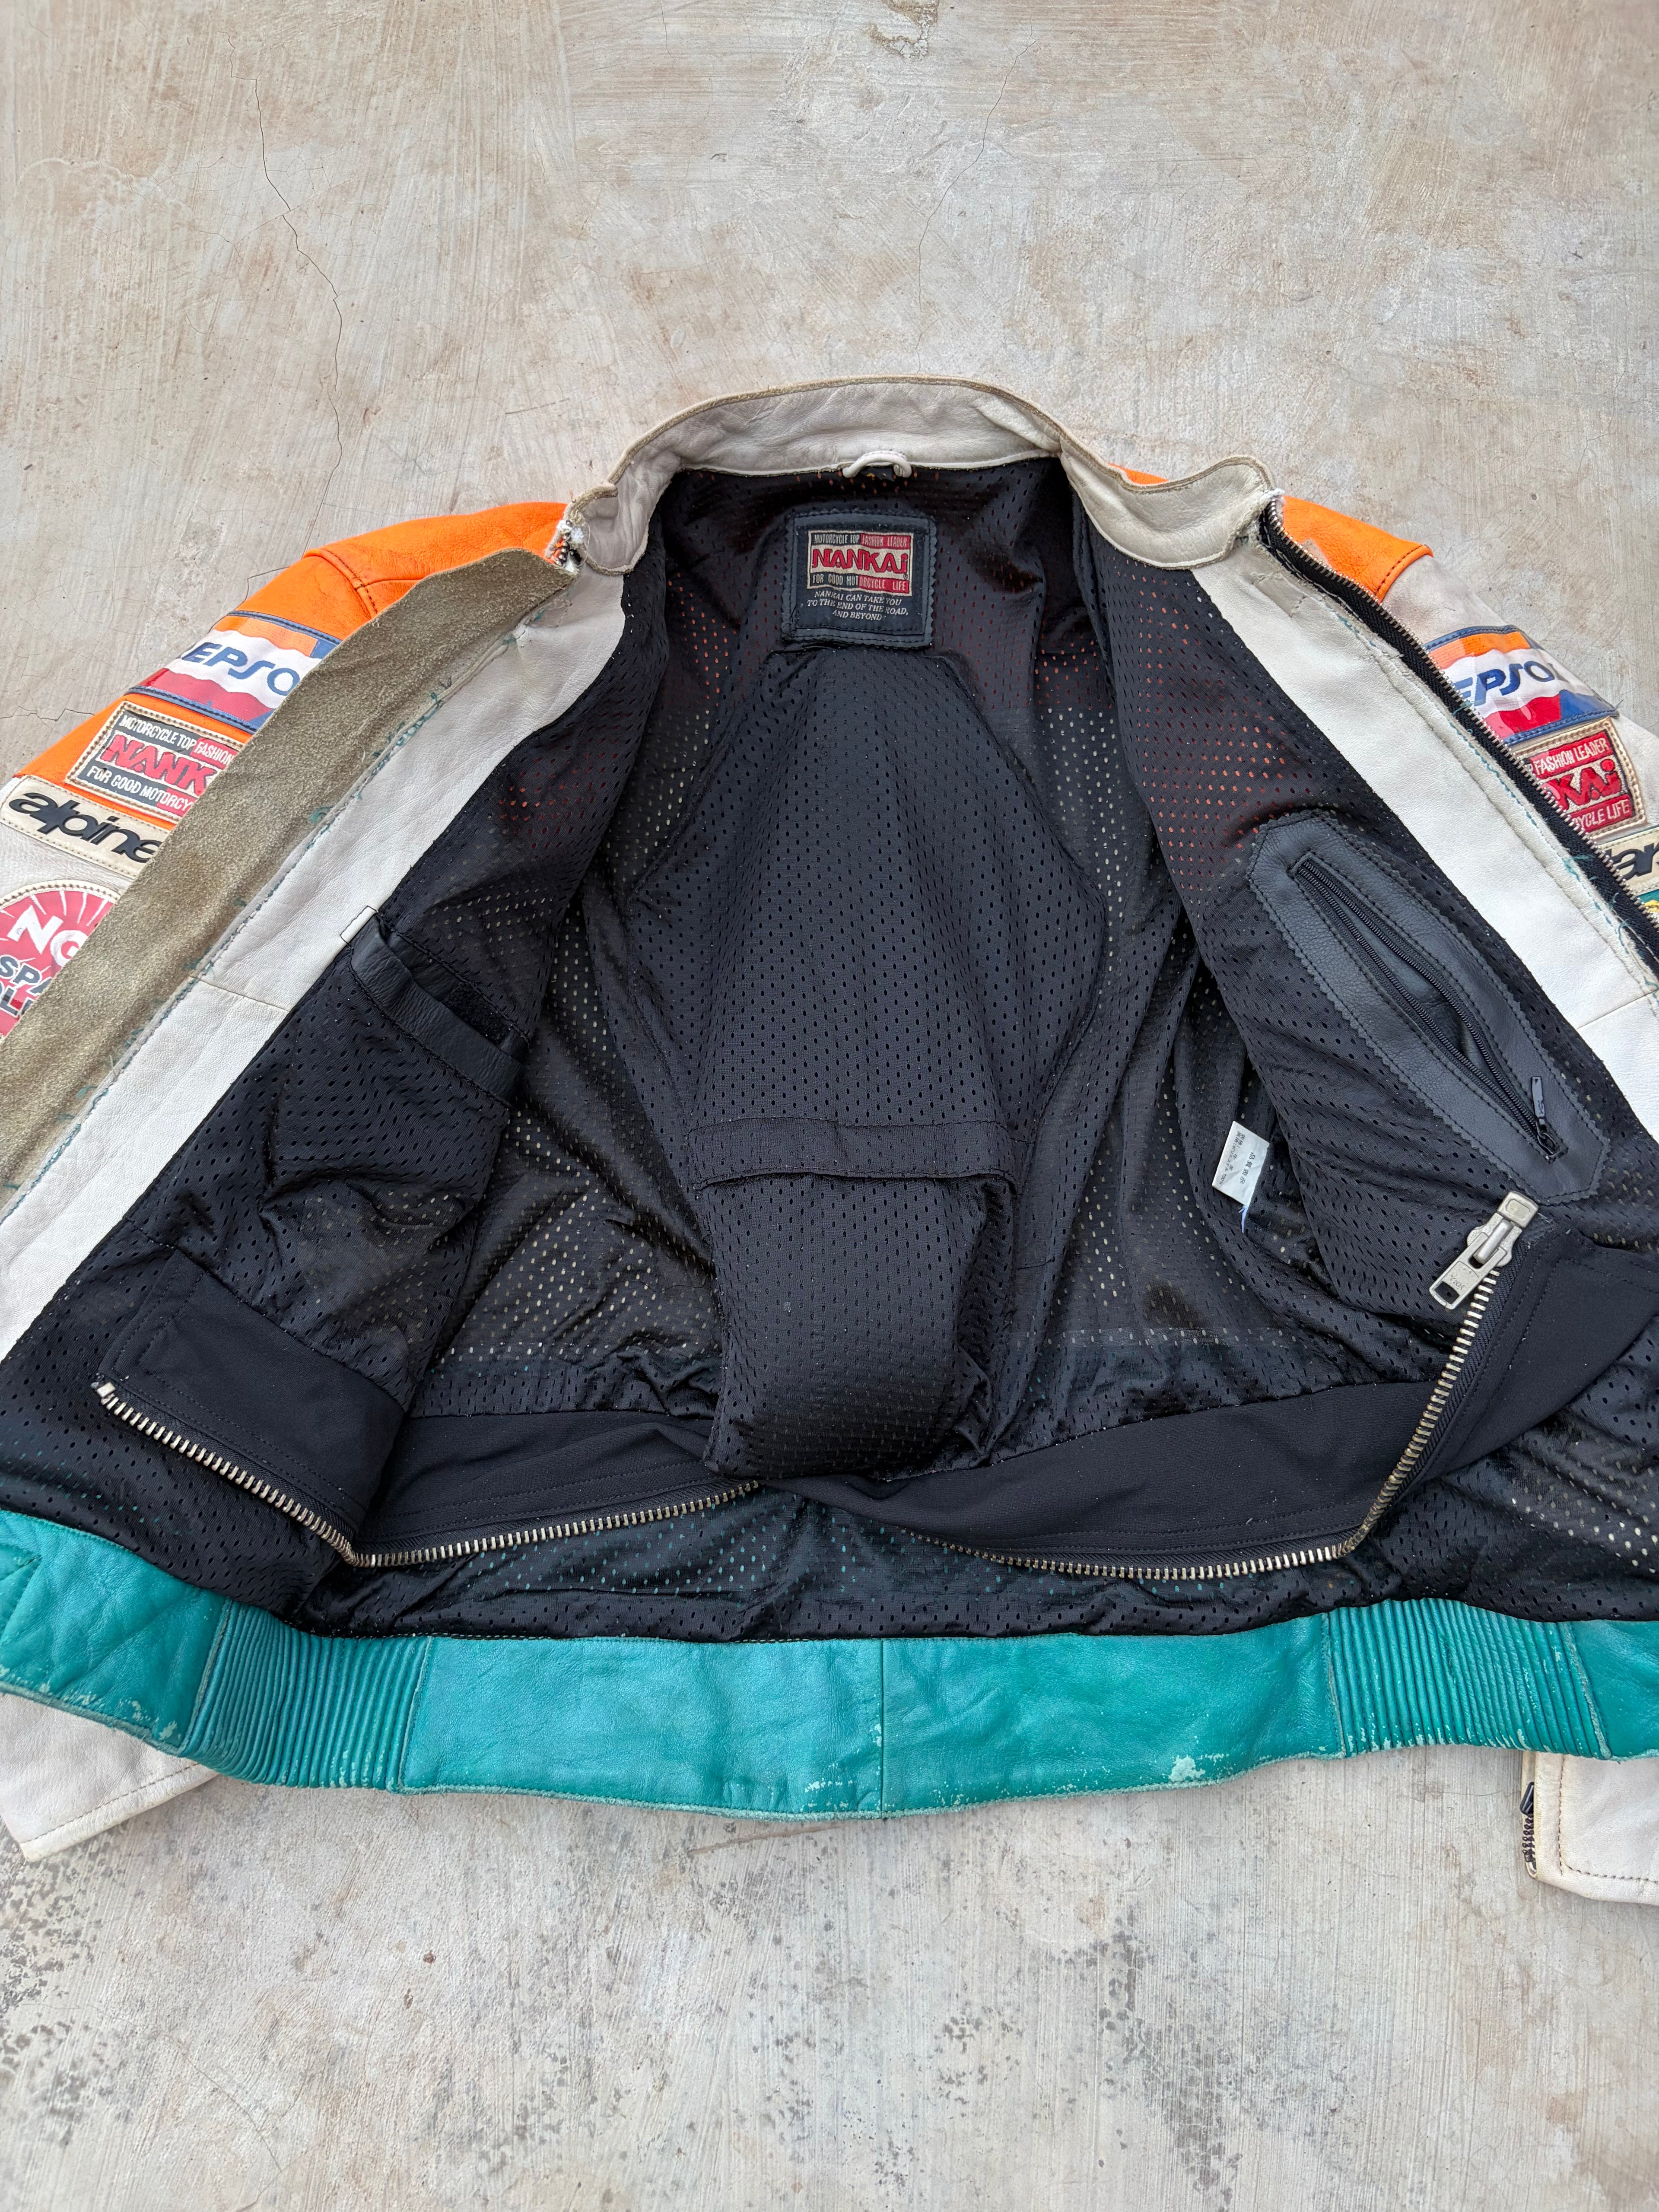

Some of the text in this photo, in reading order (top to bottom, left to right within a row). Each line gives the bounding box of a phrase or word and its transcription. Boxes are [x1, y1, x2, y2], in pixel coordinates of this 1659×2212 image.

[814, 534, 907, 547] MOTORCYCLE TOP FASHION LEADER
[813, 574, 906, 591] FOR GOOD MOTORCYCLE LIFE
[814, 591, 843, 601] NANKAI
[864, 595, 884, 604] TAKE
[833, 610, 849, 618] AND
[837, 602, 854, 610] END
[885, 607, 908, 616] ROAD,
[181, 642, 300, 696] EPSO
[119, 715, 235, 765] MOTORCYCLE TOP FASHION
[1533, 748, 1575, 775] FASHION
[1573, 738, 1610, 760] LEADER
[100, 734, 218, 796] NANK
[87, 766, 193, 811] FOR GOOD MOTORCY
[1607, 799, 1630, 820] LIFE
[9, 792, 163, 863] alpine
[7, 905, 89, 967] NG
[1240, 1152, 1255, 1184] 品質表示
